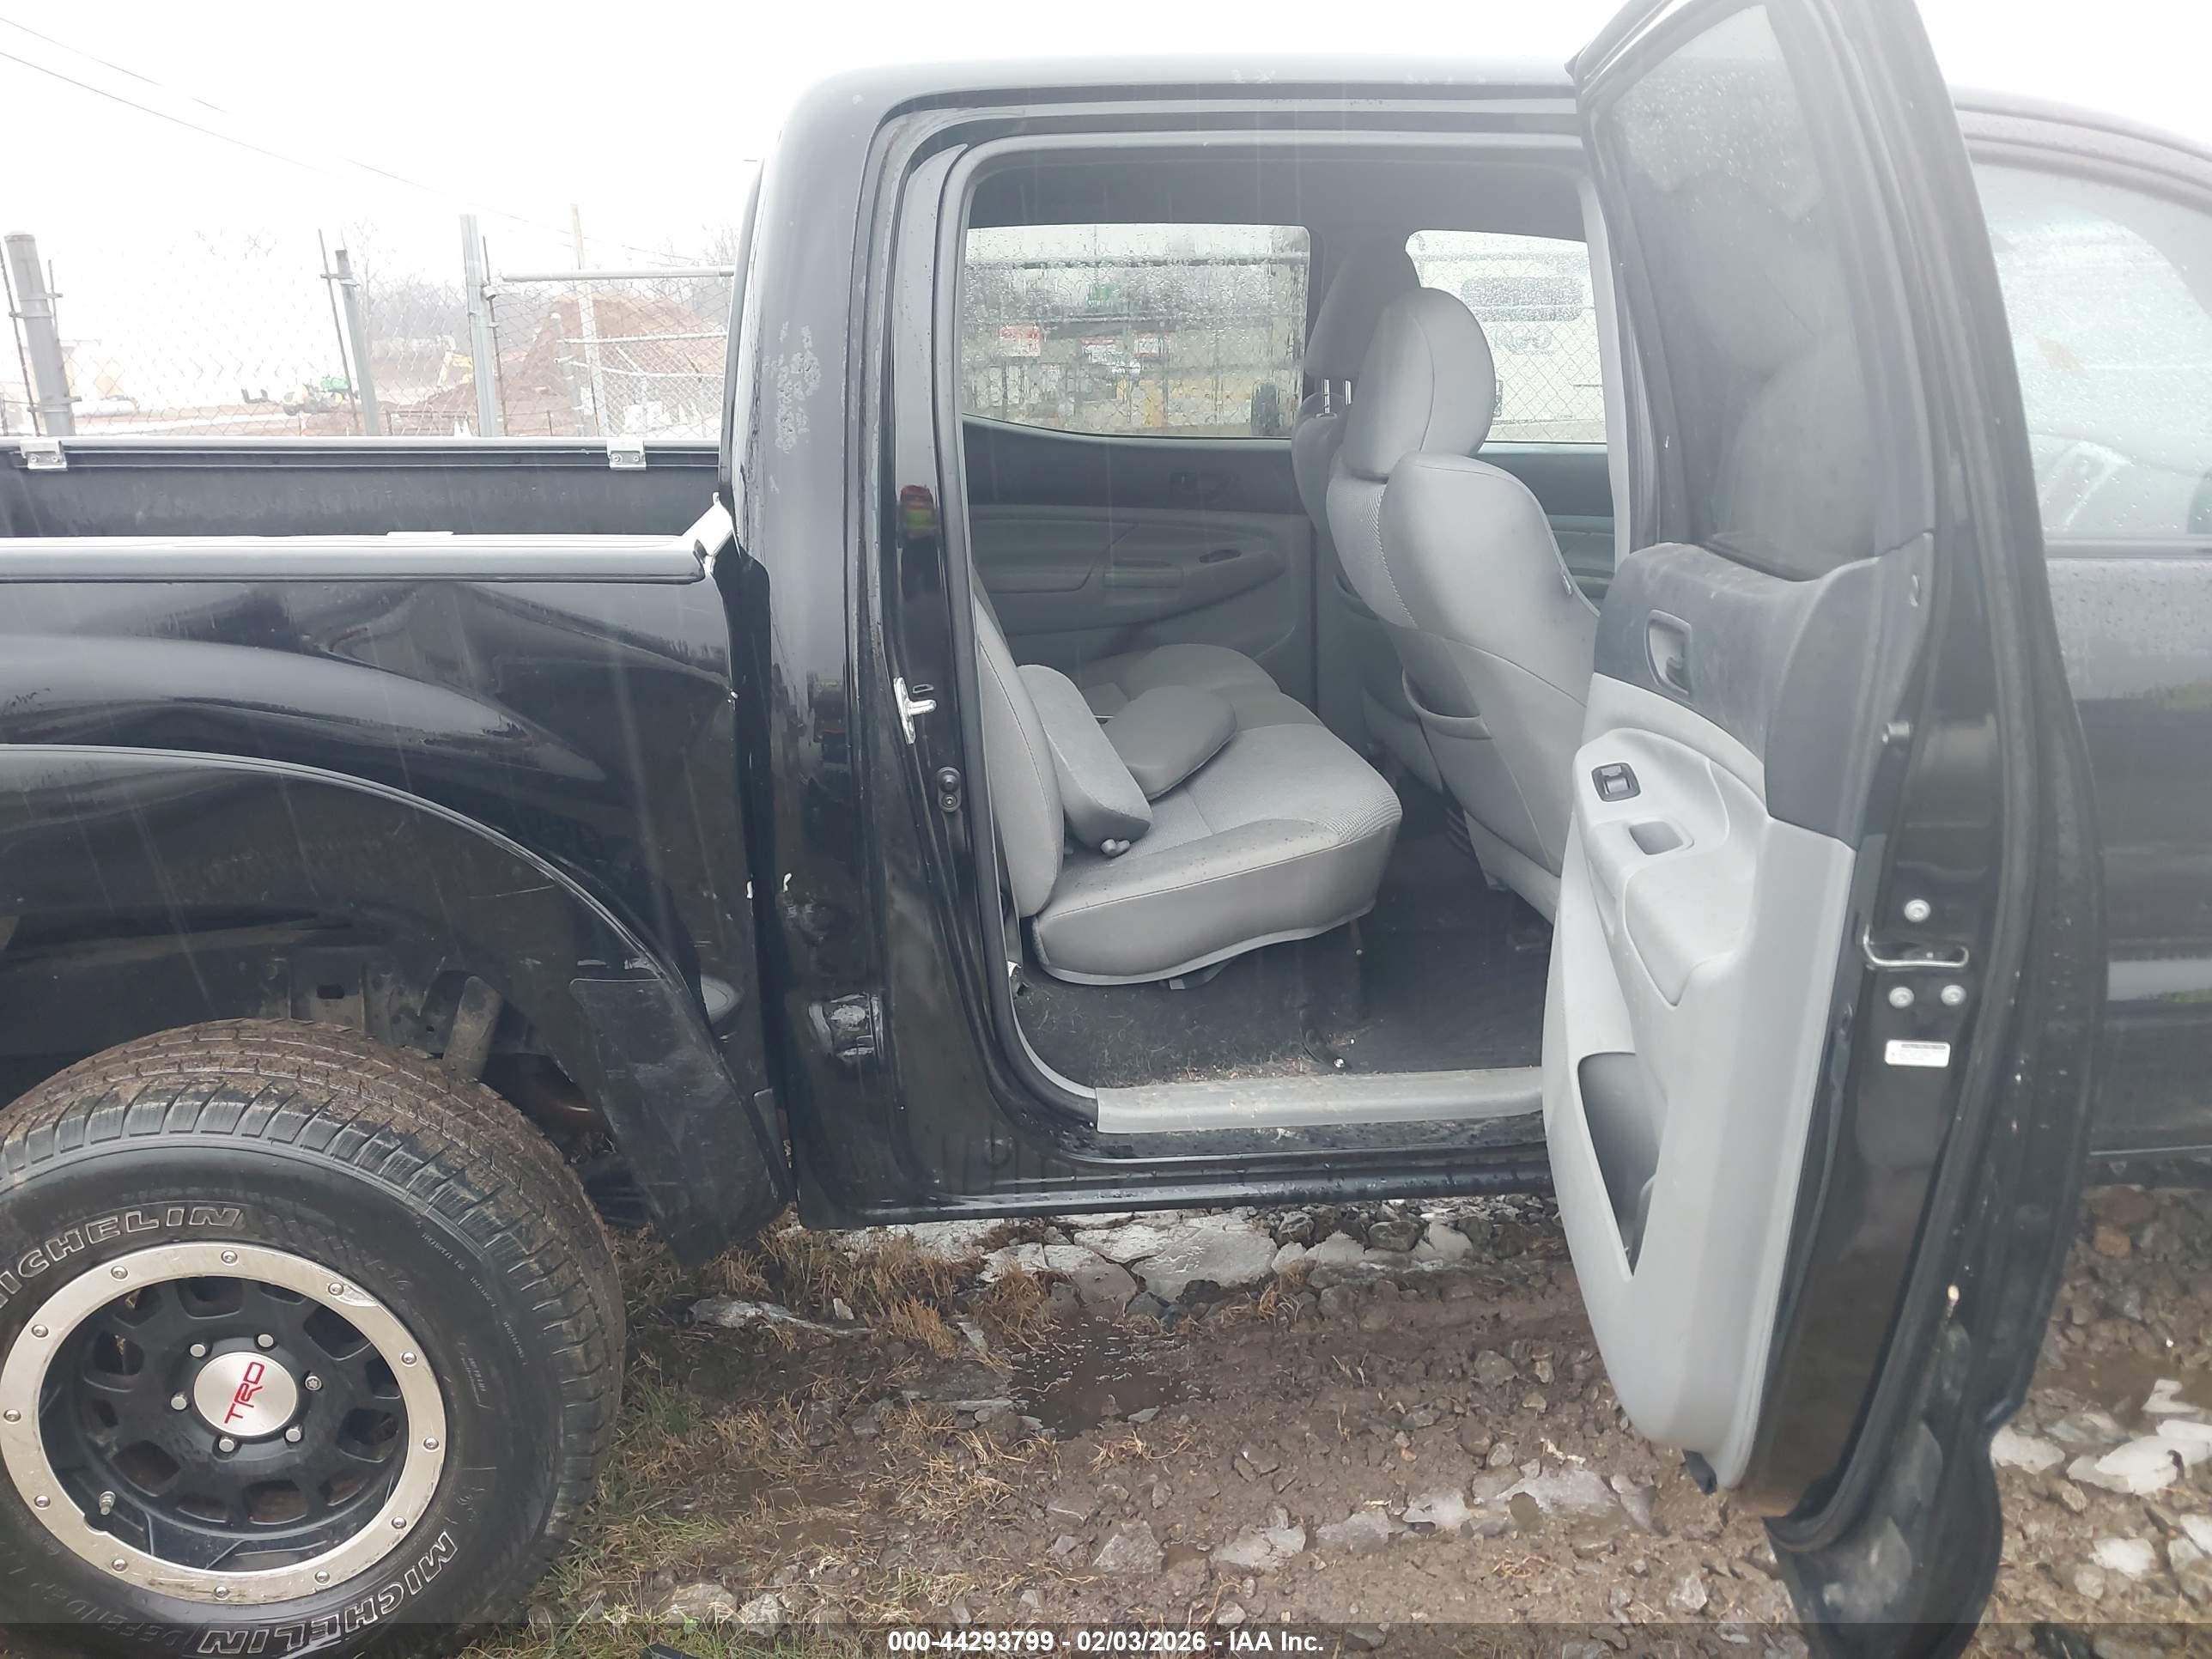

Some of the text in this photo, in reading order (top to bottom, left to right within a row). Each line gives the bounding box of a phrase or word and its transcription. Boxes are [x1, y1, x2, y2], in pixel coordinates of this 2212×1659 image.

[0, 1206, 240, 1309] ICHELIN
[223, 1361, 265, 1424] TRD
[197, 1530, 459, 1654] MICHELIN
